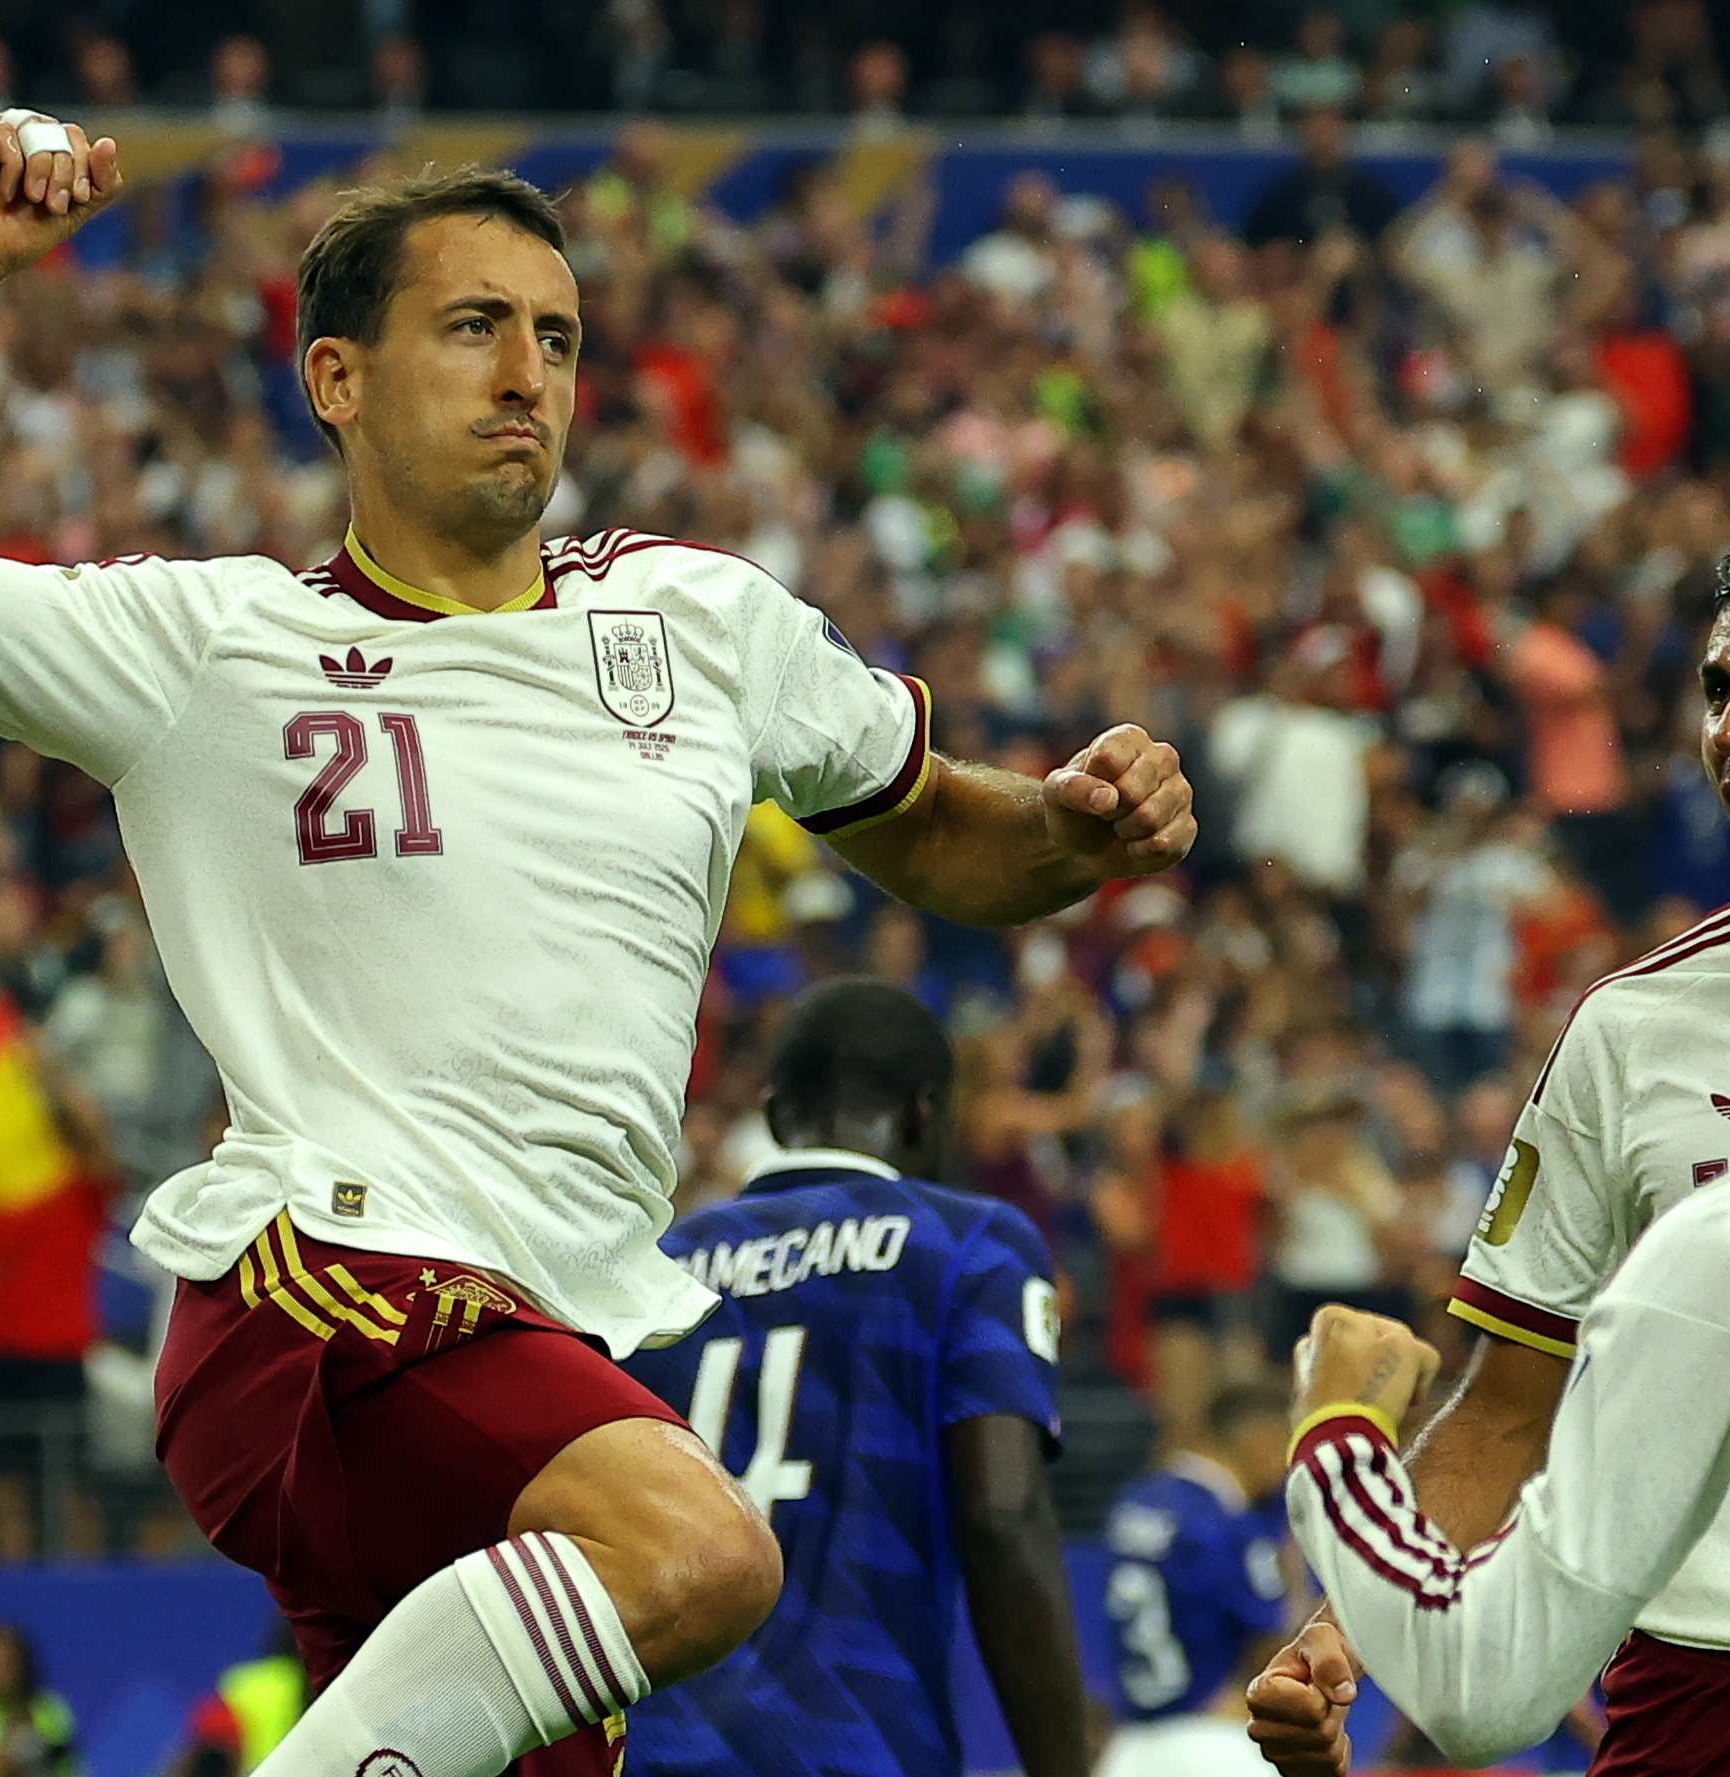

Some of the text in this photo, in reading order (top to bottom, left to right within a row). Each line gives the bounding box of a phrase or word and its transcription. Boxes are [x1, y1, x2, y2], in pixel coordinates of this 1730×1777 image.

[283, 710, 443, 866] 21
[675, 1215, 912, 1298] AMECANO
[688, 1326, 813, 1521] 4
